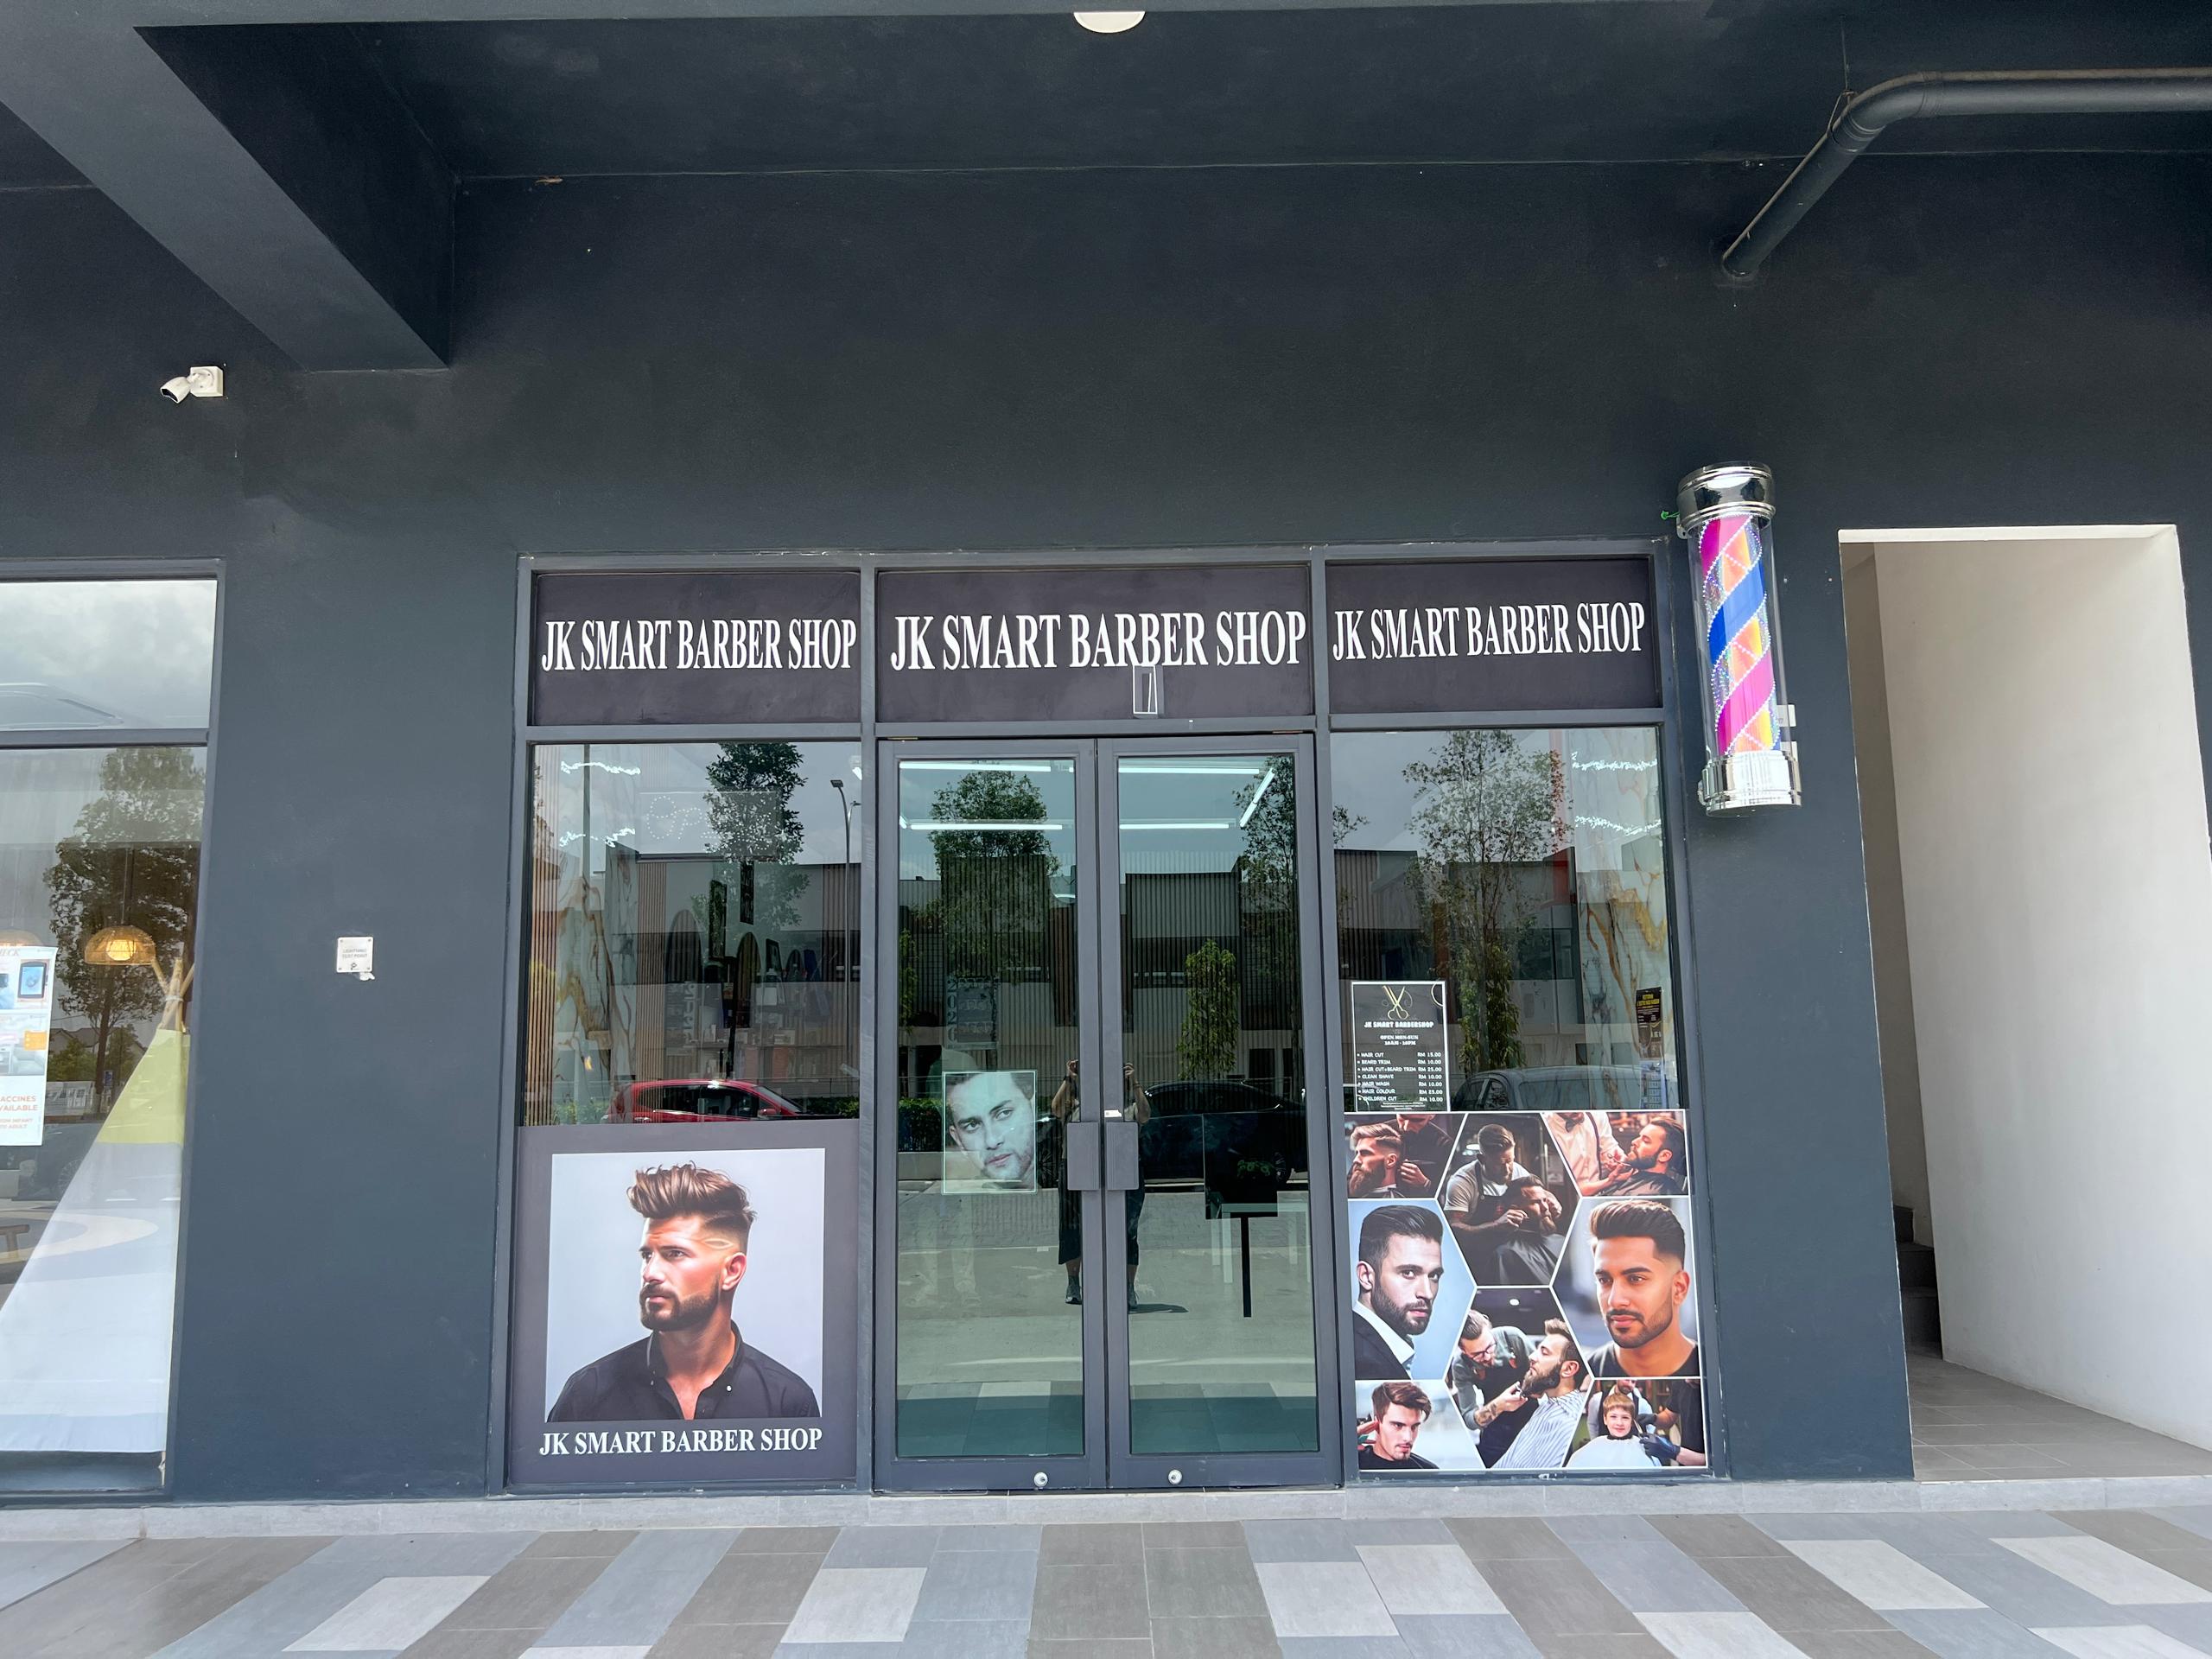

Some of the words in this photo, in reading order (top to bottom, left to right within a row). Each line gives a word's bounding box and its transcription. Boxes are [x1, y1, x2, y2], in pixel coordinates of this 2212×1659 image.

[541, 620, 576, 671] JK
[581, 620, 672, 671] SMART
[677, 619, 783, 670] BARBER
[788, 618, 857, 670] SHOP
[891, 615, 935, 671] JK
[943, 614, 1061, 670] SMART
[1069, 613, 1209, 668] BARBER
[1217, 610, 1306, 666] SHOP
[1332, 610, 1367, 661] JK
[1370, 607, 1460, 660] SMART
[1465, 605, 1573, 656] BARBER
[1577, 602, 1645, 654] SHOP
[539, 1433, 570, 1456] JK
[575, 1431, 656, 1455] SMART
[660, 1429, 756, 1453] BARBER
[760, 1427, 823, 1452] SHOP
